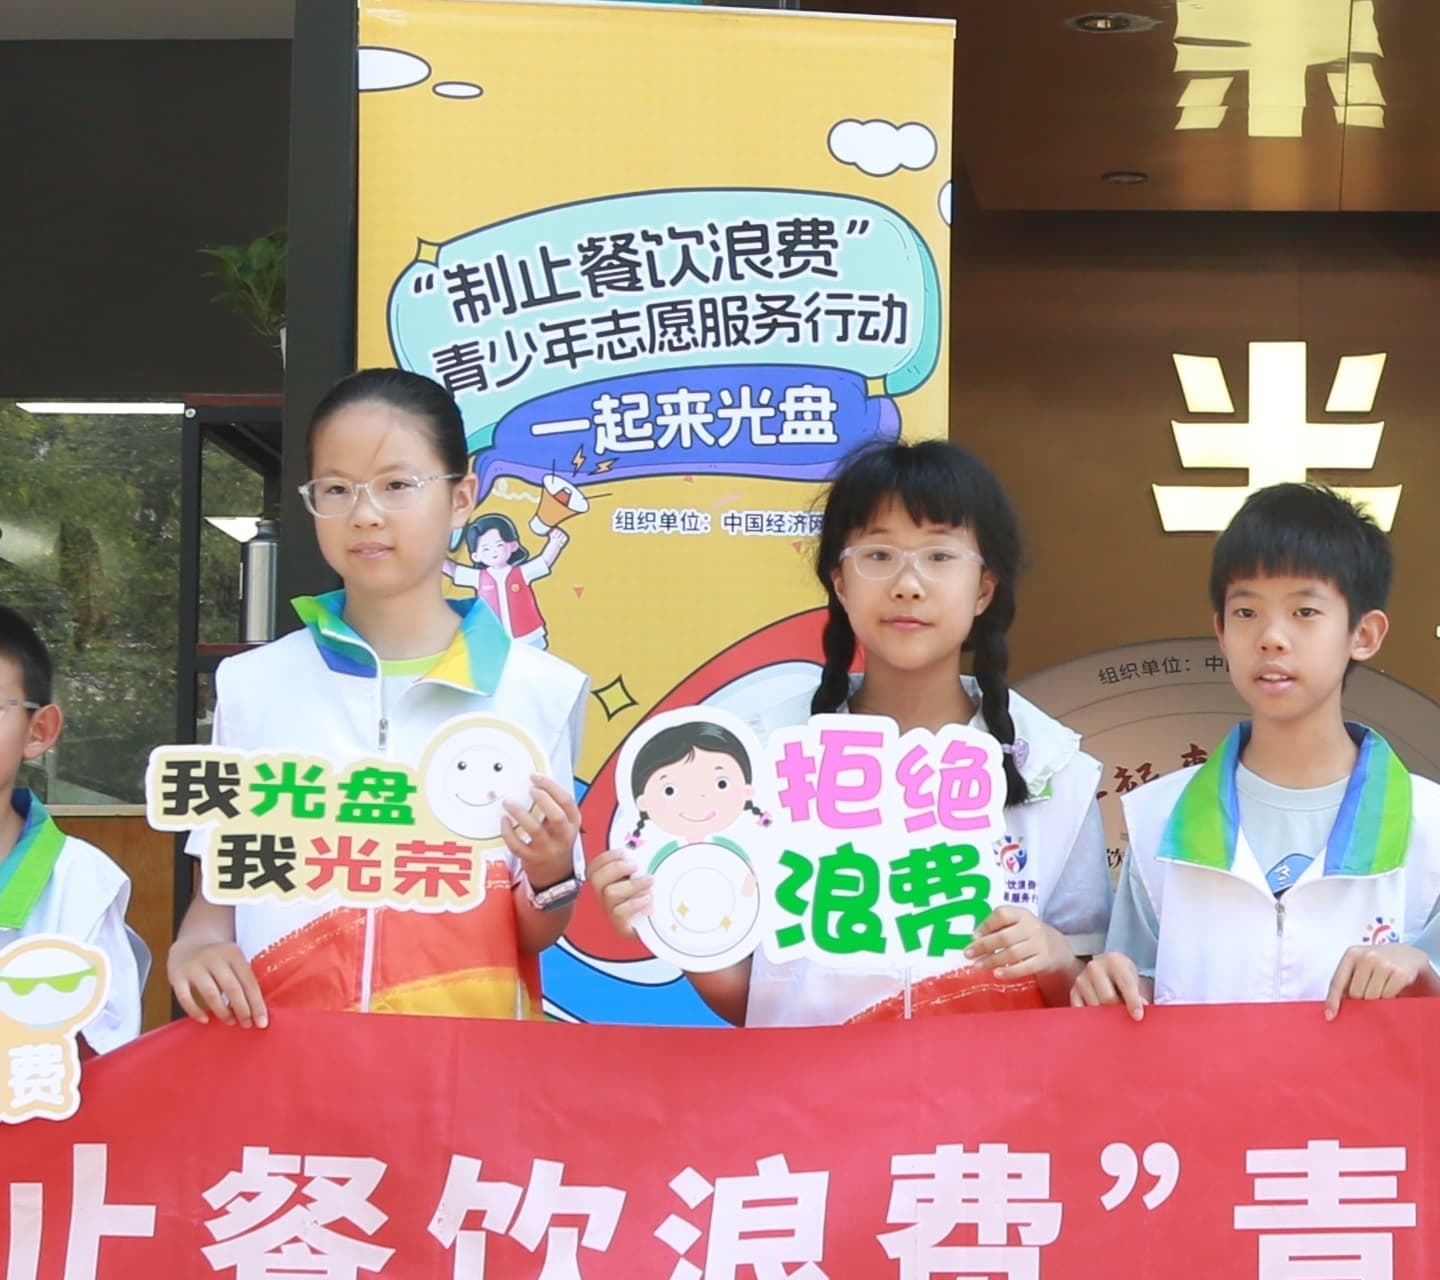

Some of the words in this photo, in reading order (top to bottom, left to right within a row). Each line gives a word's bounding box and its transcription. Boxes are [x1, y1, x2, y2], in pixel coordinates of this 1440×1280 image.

[412, 217, 871, 325] “制止餐饮浪费”
[431, 292, 910, 395] 青少年志愿服务行动
[531, 383, 839, 456] 一起来光盘
[161, 757, 419, 827] 我光盘
[775, 729, 992, 835] 拒绝
[217, 832, 481, 899] 我光荣
[774, 841, 992, 958] 浪费
